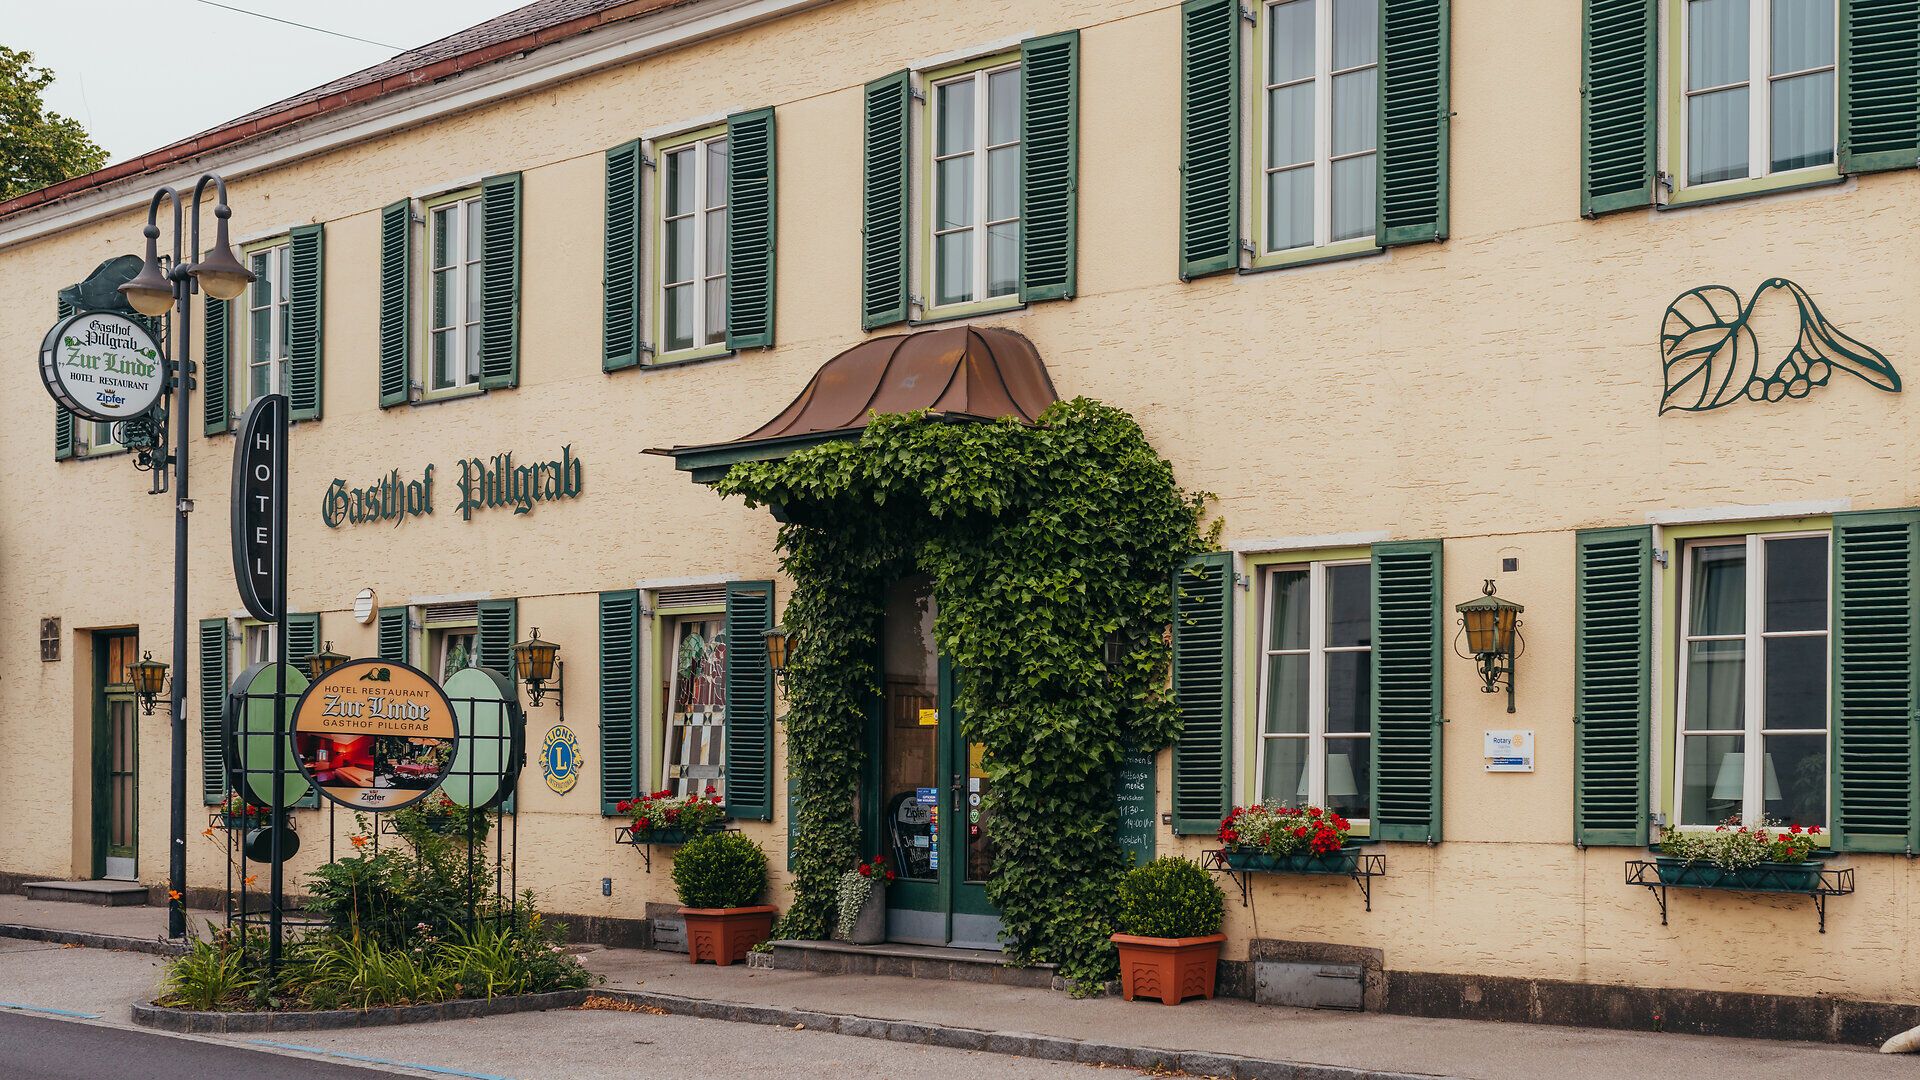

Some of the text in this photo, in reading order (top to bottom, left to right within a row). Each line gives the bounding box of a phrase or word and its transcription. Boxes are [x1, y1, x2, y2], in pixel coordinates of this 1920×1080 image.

[89, 319, 132, 337] Gasthof
[85, 329, 138, 351] Pillgrab
[70, 372, 150, 391] HOTEL RESTAURANT
[96, 391, 126, 405] Zipfer
[321, 443, 582, 530] Gasthof Pillgrab
[255, 432, 271, 576] HOTEL
[324, 685, 430, 698] HOTEL RESTAURANT
[322, 694, 431, 722] Zur Linde
[322, 719, 430, 731] GASTHOF PILLGRAB
[547, 727, 573, 743] LIONS
[1493, 737, 1512, 745] Rotary
[555, 747, 568, 771] L
[361, 792, 386, 802] Zipfer
[904, 807, 928, 821] Zipfer
